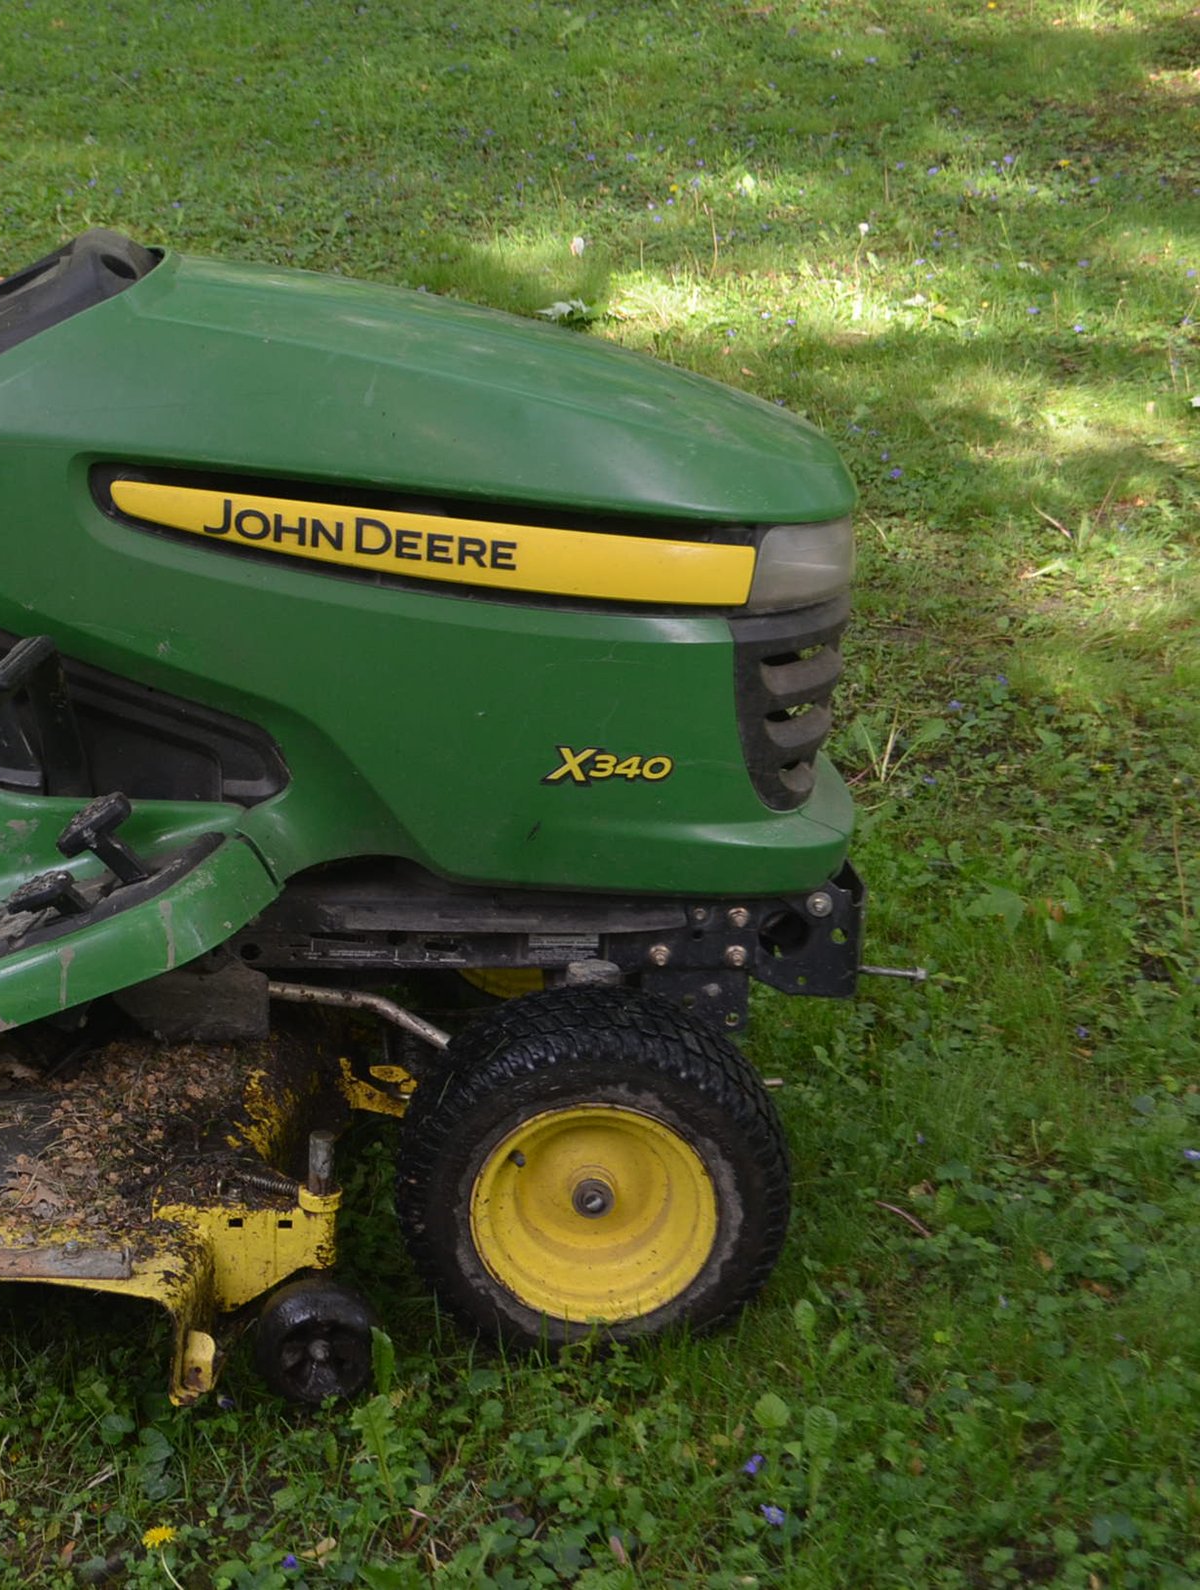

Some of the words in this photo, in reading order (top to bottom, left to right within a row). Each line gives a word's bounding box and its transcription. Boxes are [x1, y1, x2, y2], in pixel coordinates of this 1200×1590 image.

[203, 499, 343, 552] JOHN
[355, 517, 517, 571] DEERE
[541, 746, 675, 786] X340
